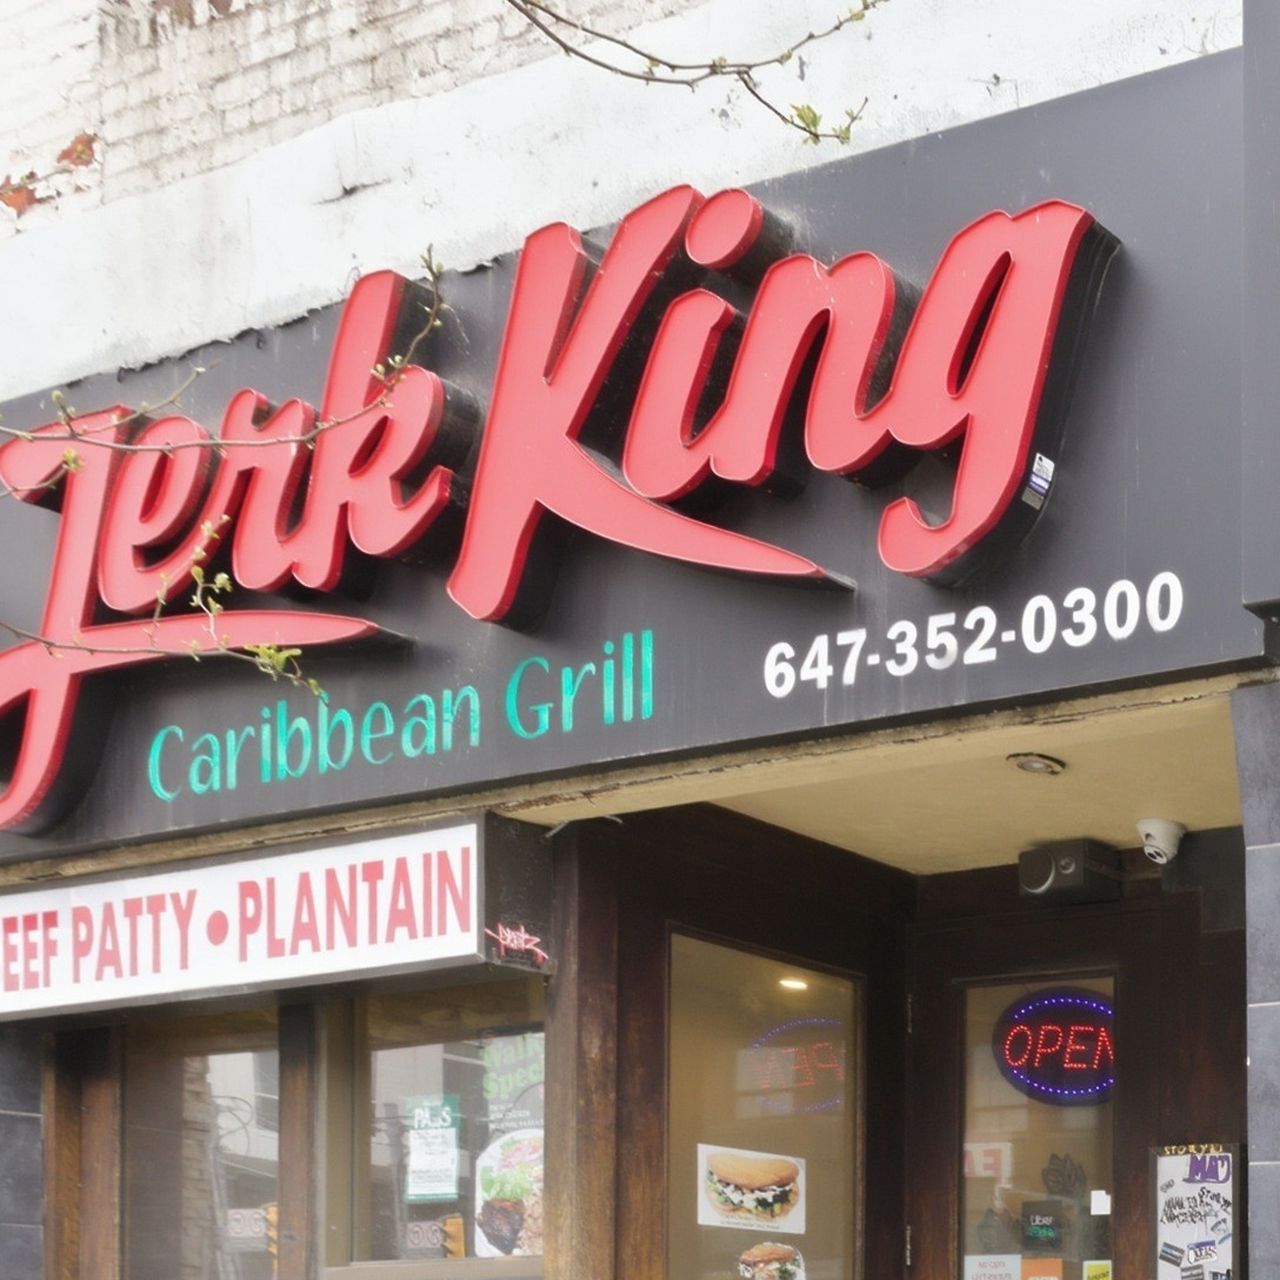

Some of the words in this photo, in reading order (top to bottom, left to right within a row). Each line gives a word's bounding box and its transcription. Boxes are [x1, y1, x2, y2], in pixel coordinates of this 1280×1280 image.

[0, 267, 455, 830] Jerk
[446, 184, 1096, 621] King
[761, 571, 1185, 700] 647-352-0300
[147, 688, 481, 801] Caribbean
[505, 628, 655, 740] Grill
[71, 888, 198, 985] PATTY
[238, 845, 473, 962] PLANTAIN
